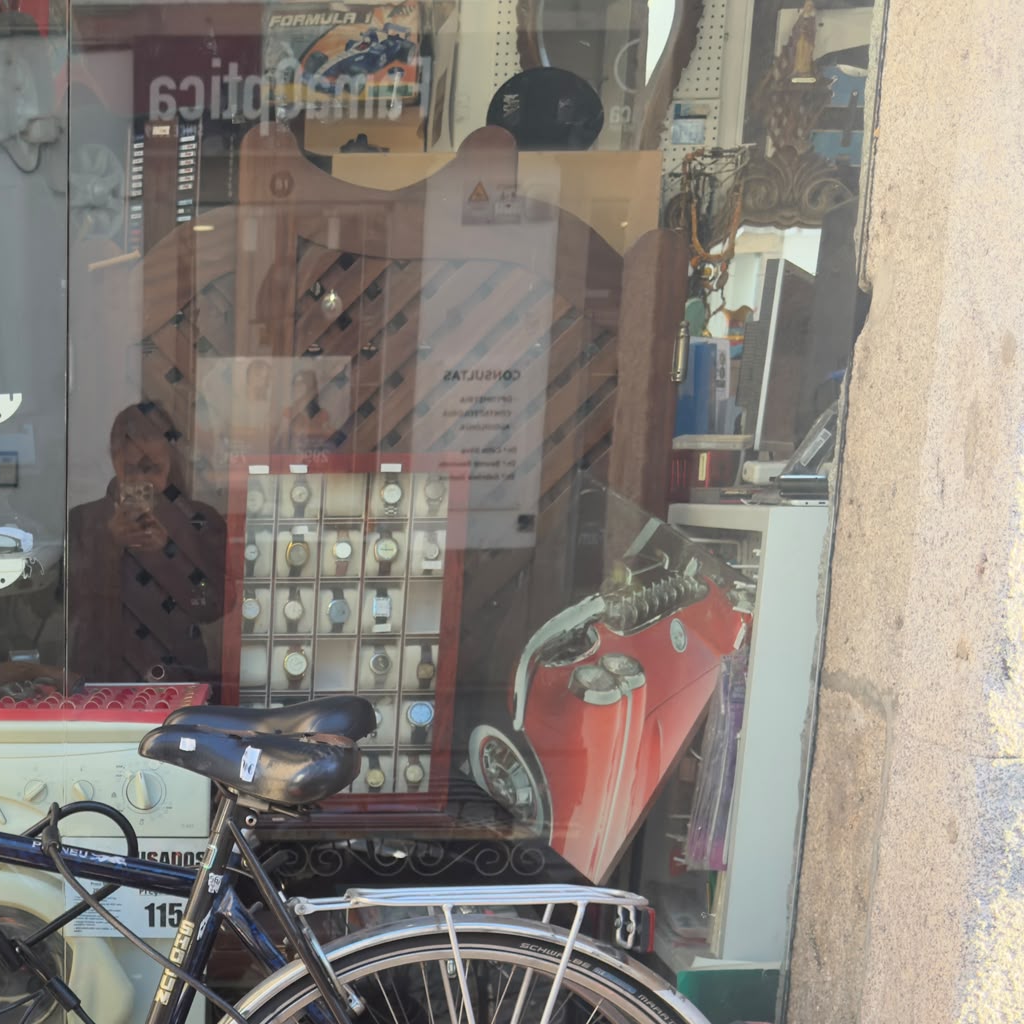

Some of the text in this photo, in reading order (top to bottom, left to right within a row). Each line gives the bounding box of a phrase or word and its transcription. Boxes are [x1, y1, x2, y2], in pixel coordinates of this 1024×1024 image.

[269, 12, 373, 27] FORMULA 1
[31, 840, 88, 859] PNEU
[144, 902, 183, 928] 115
[154, 919, 195, 1006] SHOUN
[519, 942, 592, 969] SCHWBE
